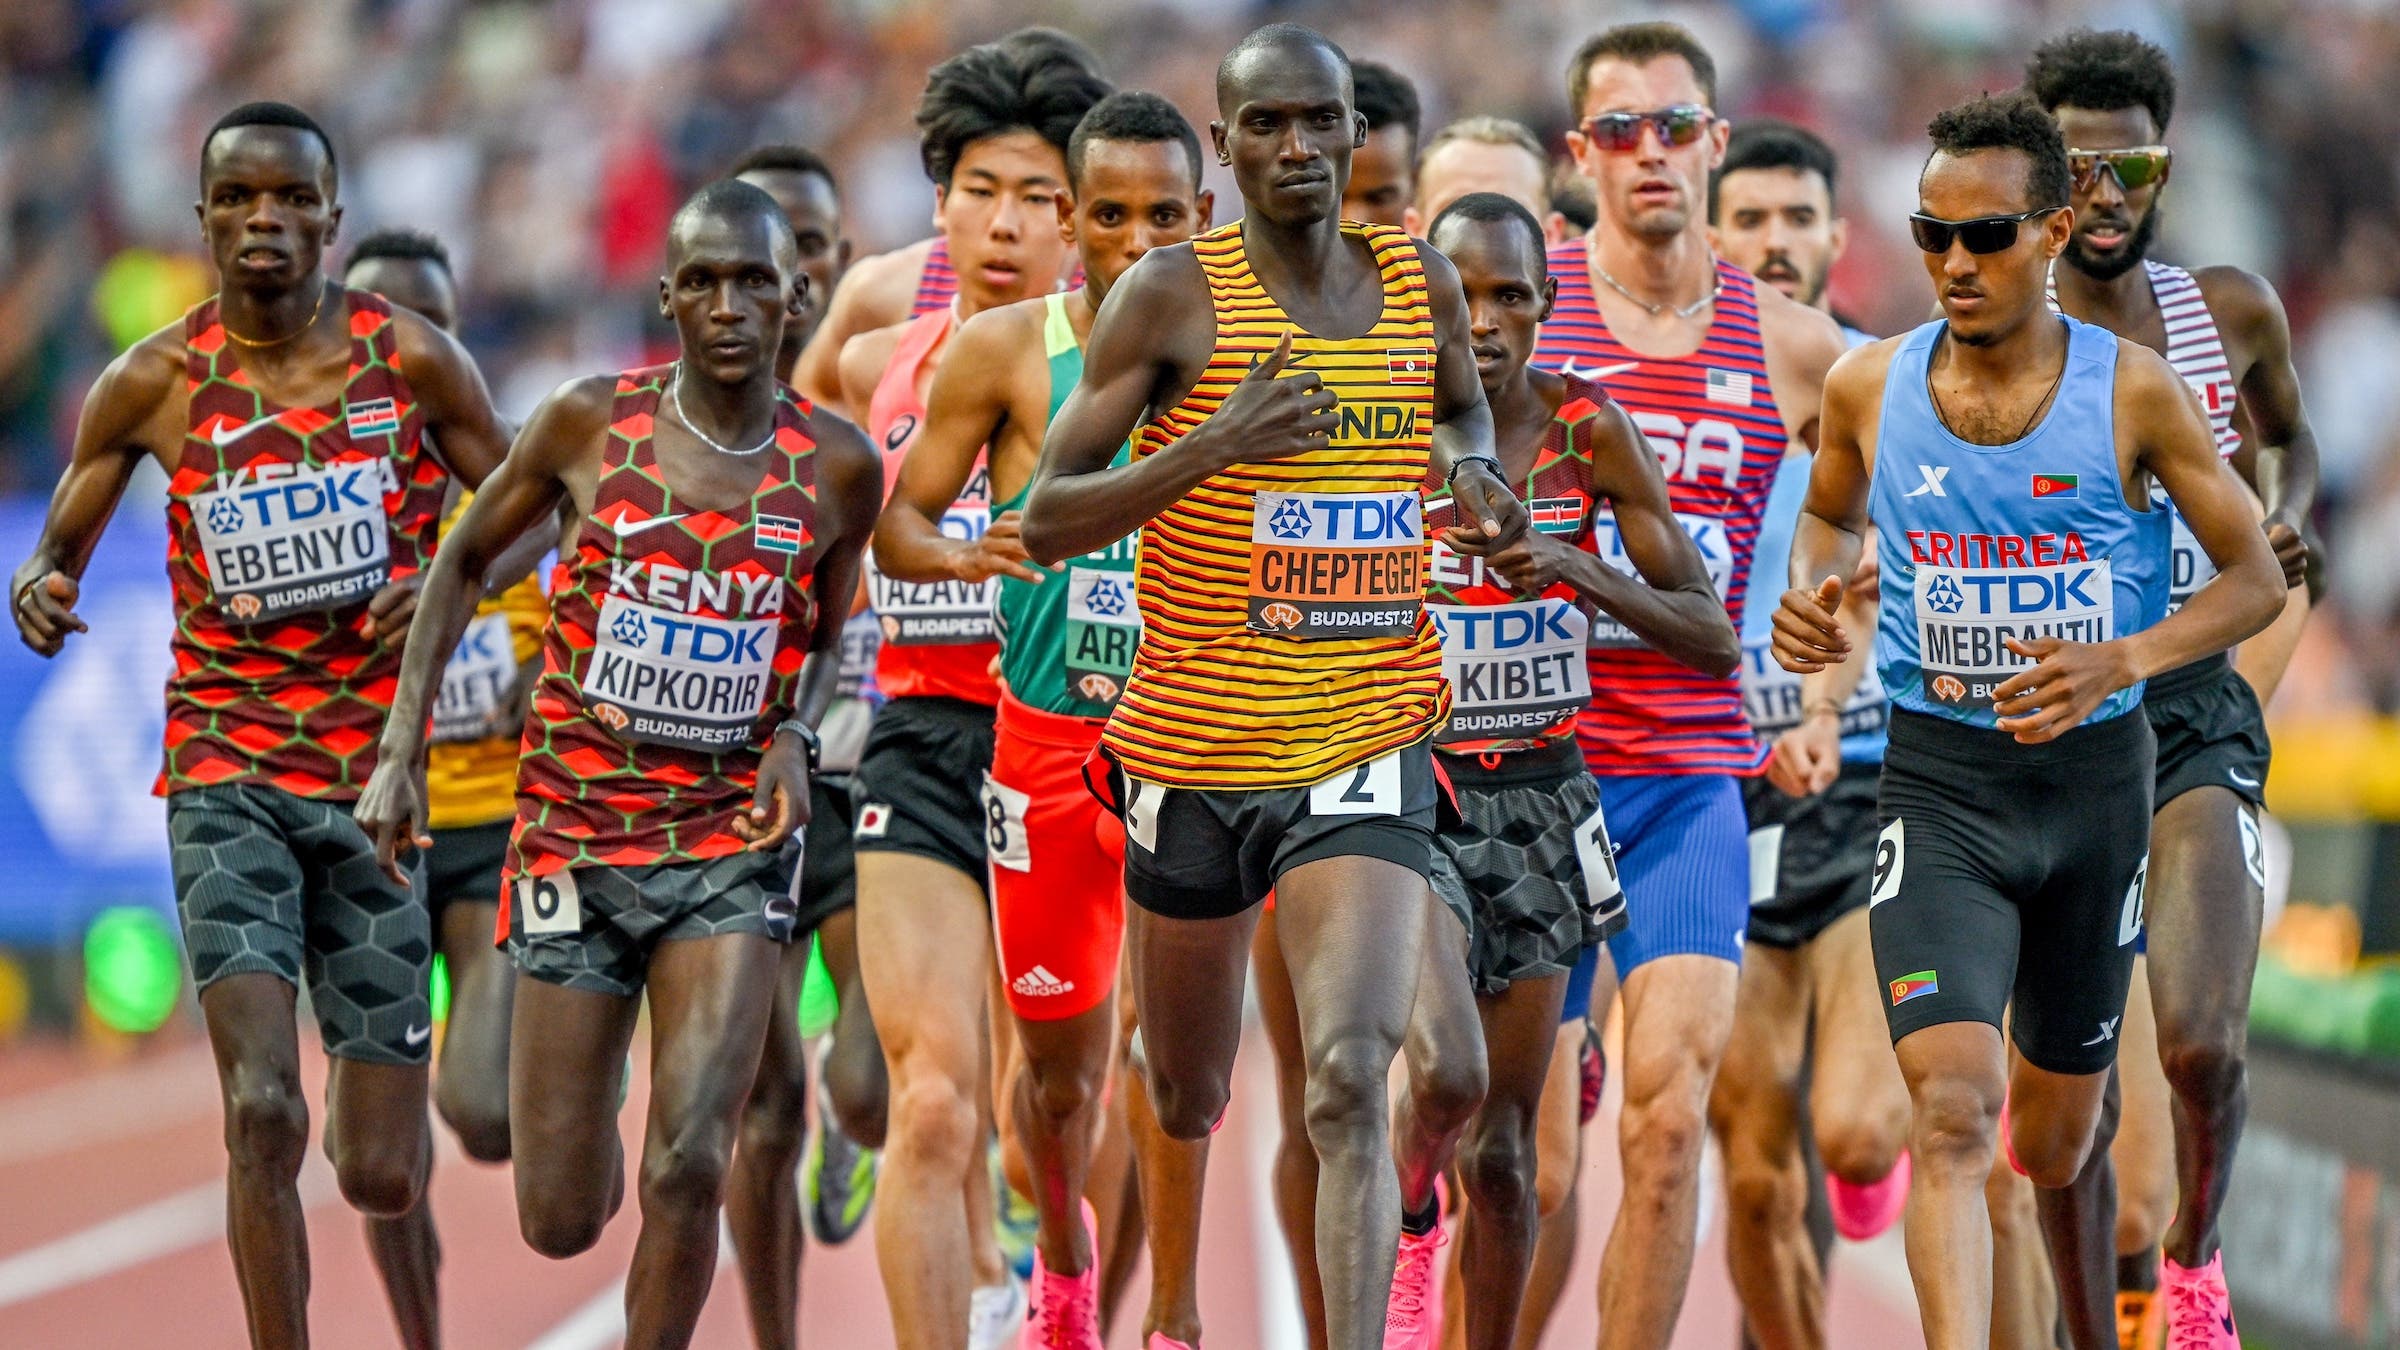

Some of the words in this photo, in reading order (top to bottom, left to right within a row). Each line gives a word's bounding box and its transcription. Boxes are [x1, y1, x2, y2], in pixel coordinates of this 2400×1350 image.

[240, 469, 369, 526] TDK
[1312, 498, 1416, 540] TDK
[215, 519, 374, 587] EBENYO
[1260, 550, 1418, 595] CHEPTEGEI
[1905, 530, 2090, 569] ERITREA
[609, 557, 786, 615] KENYA
[1962, 568, 2100, 615] TDK
[651, 616, 769, 665] TDK
[1447, 603, 1575, 650] TDK
[595, 651, 761, 718] KIPKORIR
[1459, 650, 1576, 703] KIBET
[1339, 762, 1375, 803] 2
[988, 795, 1007, 853] 8
[1872, 839, 1897, 896] 9
[532, 876, 560, 920] 6
[1012, 981, 1075, 997] adidas
